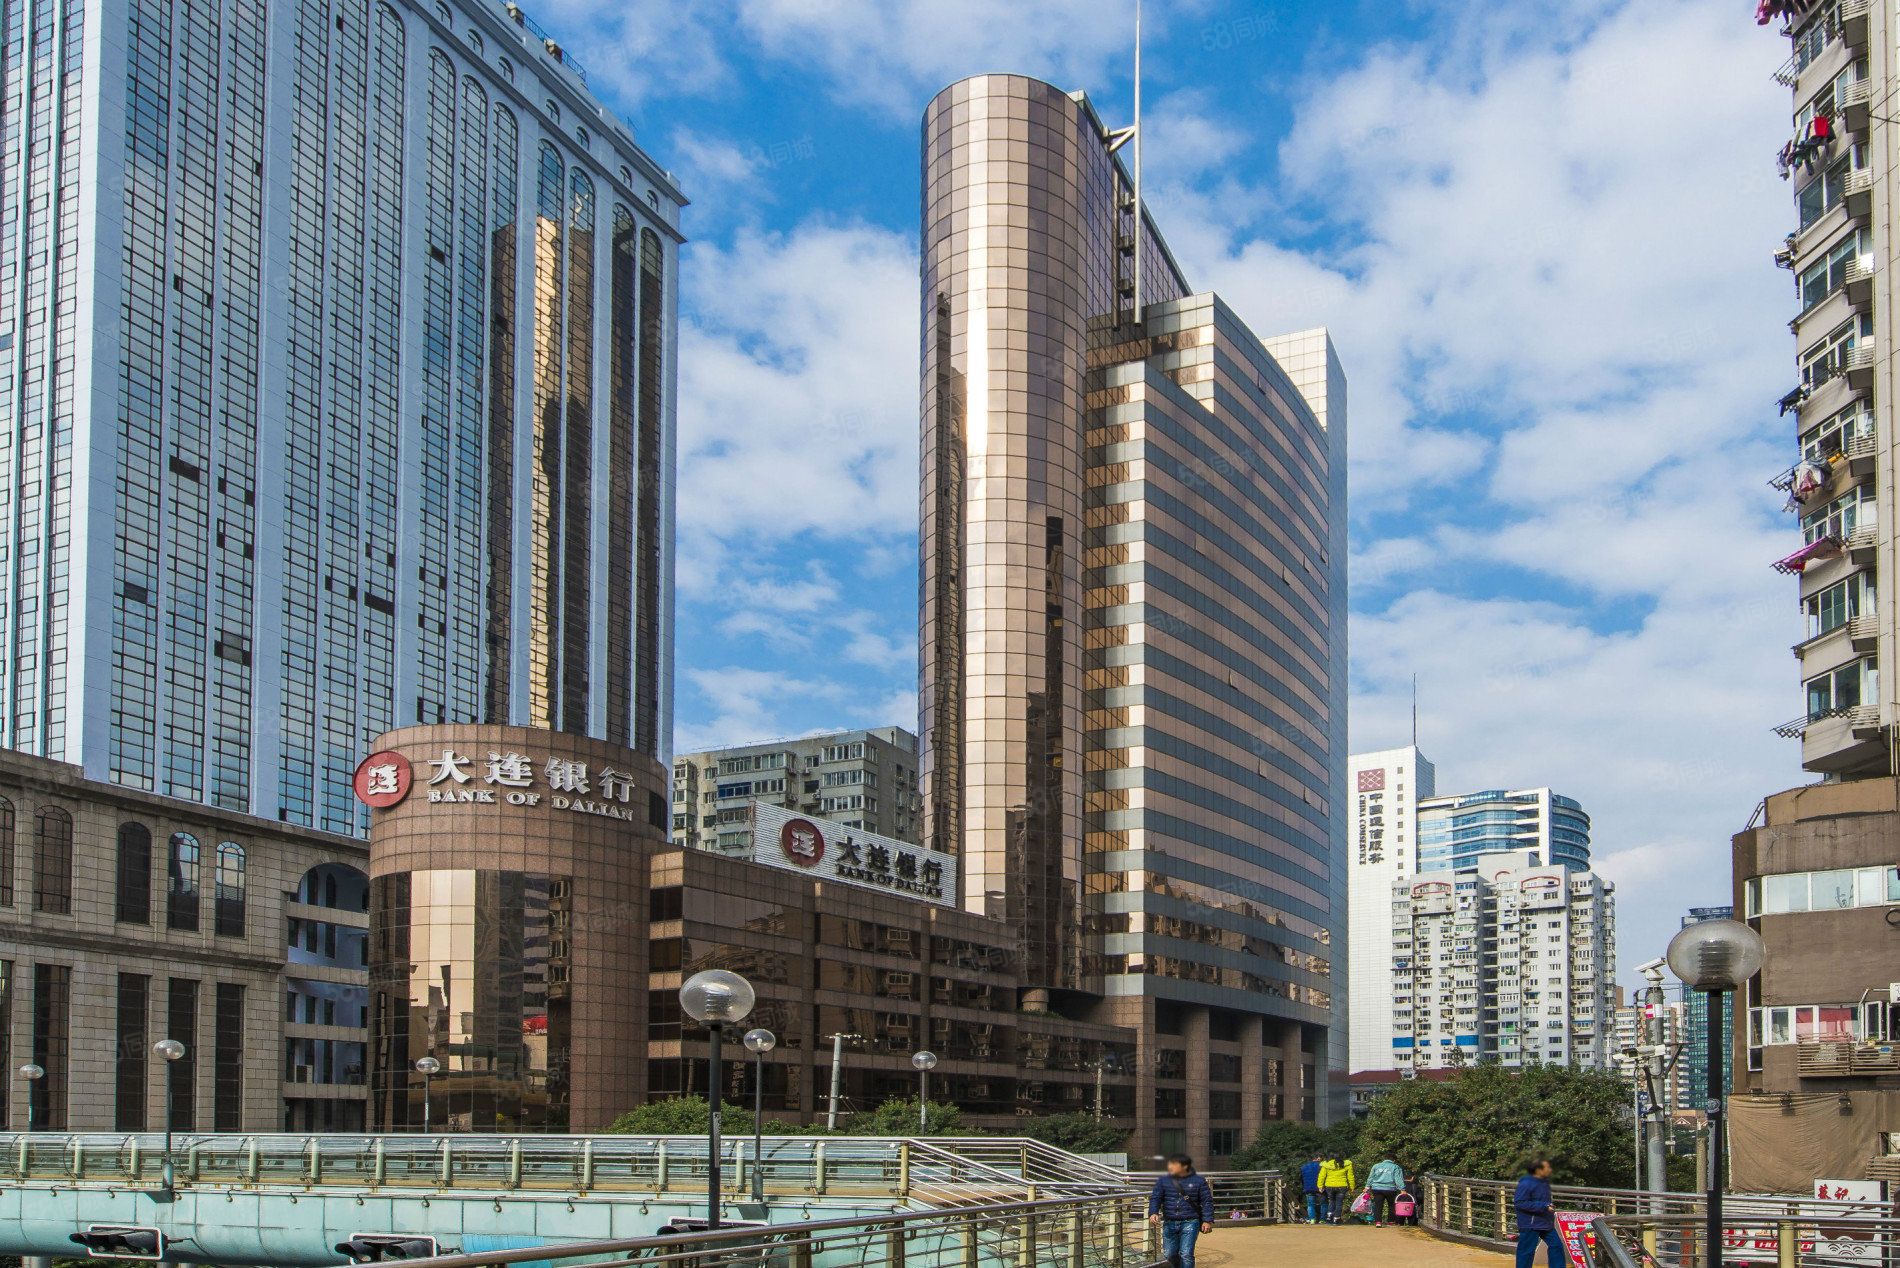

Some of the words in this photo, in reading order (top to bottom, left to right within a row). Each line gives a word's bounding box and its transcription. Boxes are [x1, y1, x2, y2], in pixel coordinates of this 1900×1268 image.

[426, 749, 635, 803] 大连银行
[427, 788, 495, 803] BANK
[506, 791, 541, 806] OF
[551, 794, 634, 822] DALIAN
[1368, 793, 1384, 865] 中国通信服务
[835, 834, 943, 886] 大连银行
[835, 863, 875, 883] BANK
[876, 874, 894, 886] OF
[895, 877, 944, 899] DALIAN
